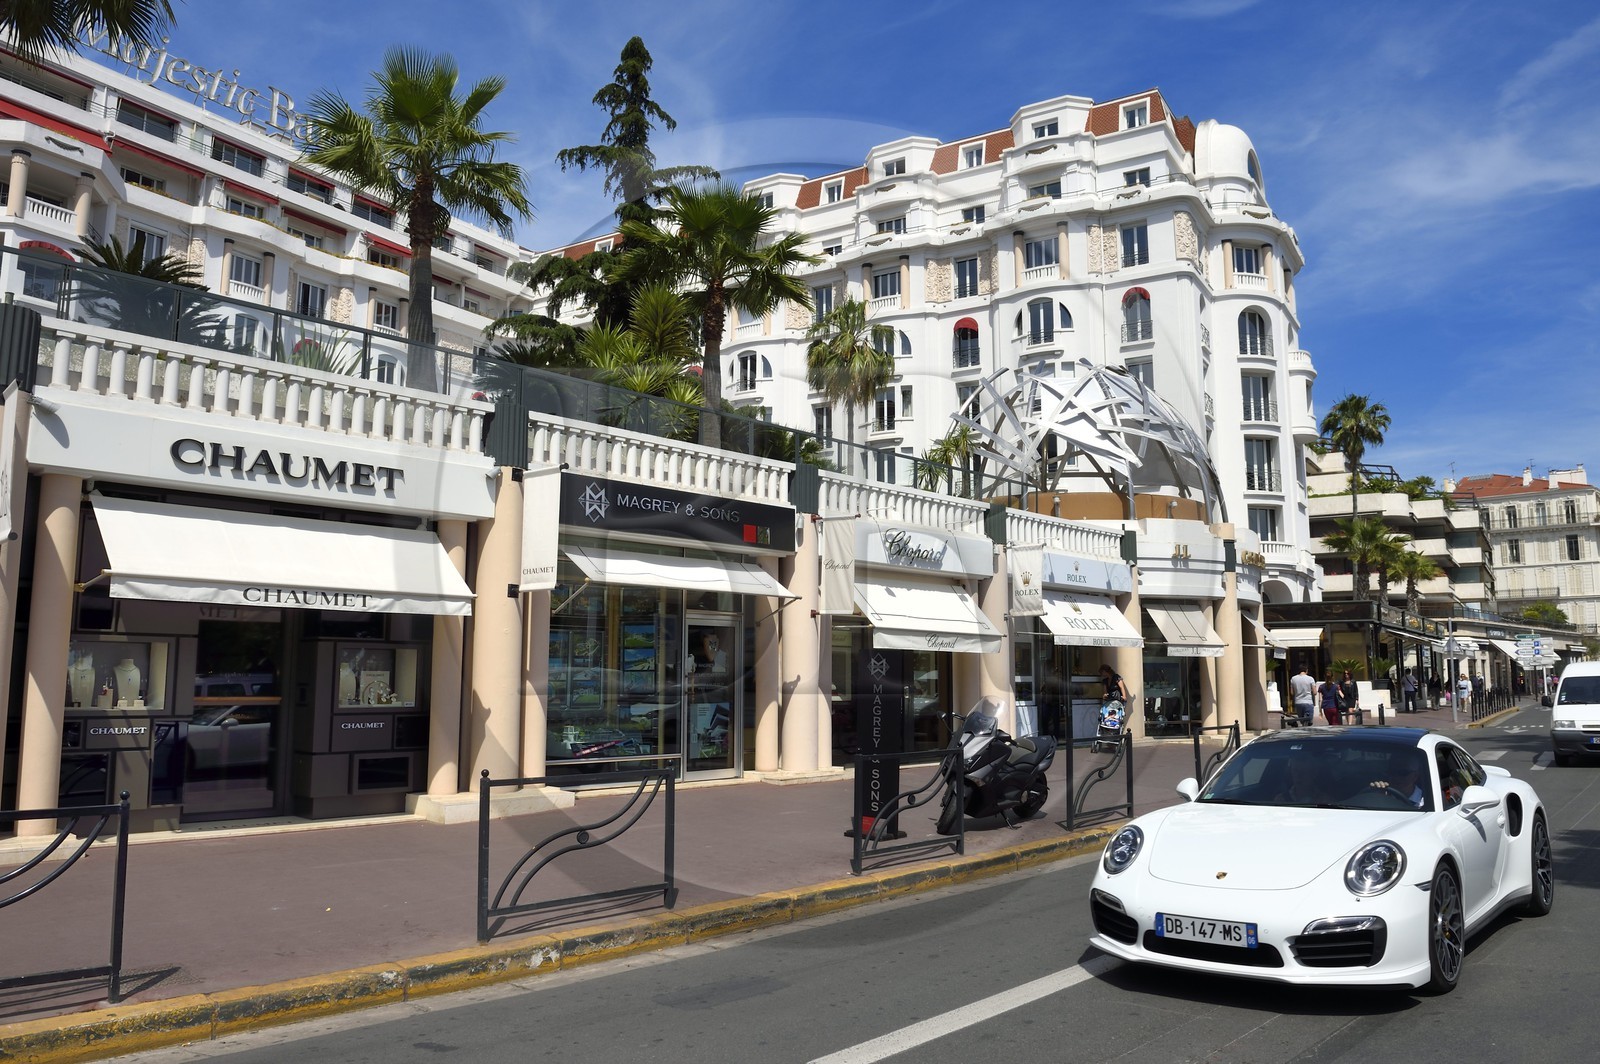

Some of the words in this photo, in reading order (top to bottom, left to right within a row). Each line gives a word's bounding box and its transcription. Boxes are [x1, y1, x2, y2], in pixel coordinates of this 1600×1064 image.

[170, 438, 405, 491] CHAUMET
[617, 493, 681, 515] MAGREY
[685, 503, 695, 517] &
[700, 506, 740, 523] SONS
[884, 528, 948, 565] Chopard
[522, 566, 556, 576] CHAUMET
[823, 559, 854, 571] Chopard
[1066, 573, 1087, 584] ROLEX
[242, 587, 373, 608] CHAUMET
[1014, 588, 1039, 597] ROLEX
[1063, 616, 1114, 631] ROLEX
[925, 633, 959, 651] Chopard
[1092, 638, 1112, 646] ROLEX
[872, 684, 883, 748] MAGREY
[89, 727, 147, 735] CHAUMET
[341, 722, 385, 730] CHAUMET
[870, 769, 881, 812] SONS
[1165, 917, 1242, 942] DB-147-MS
